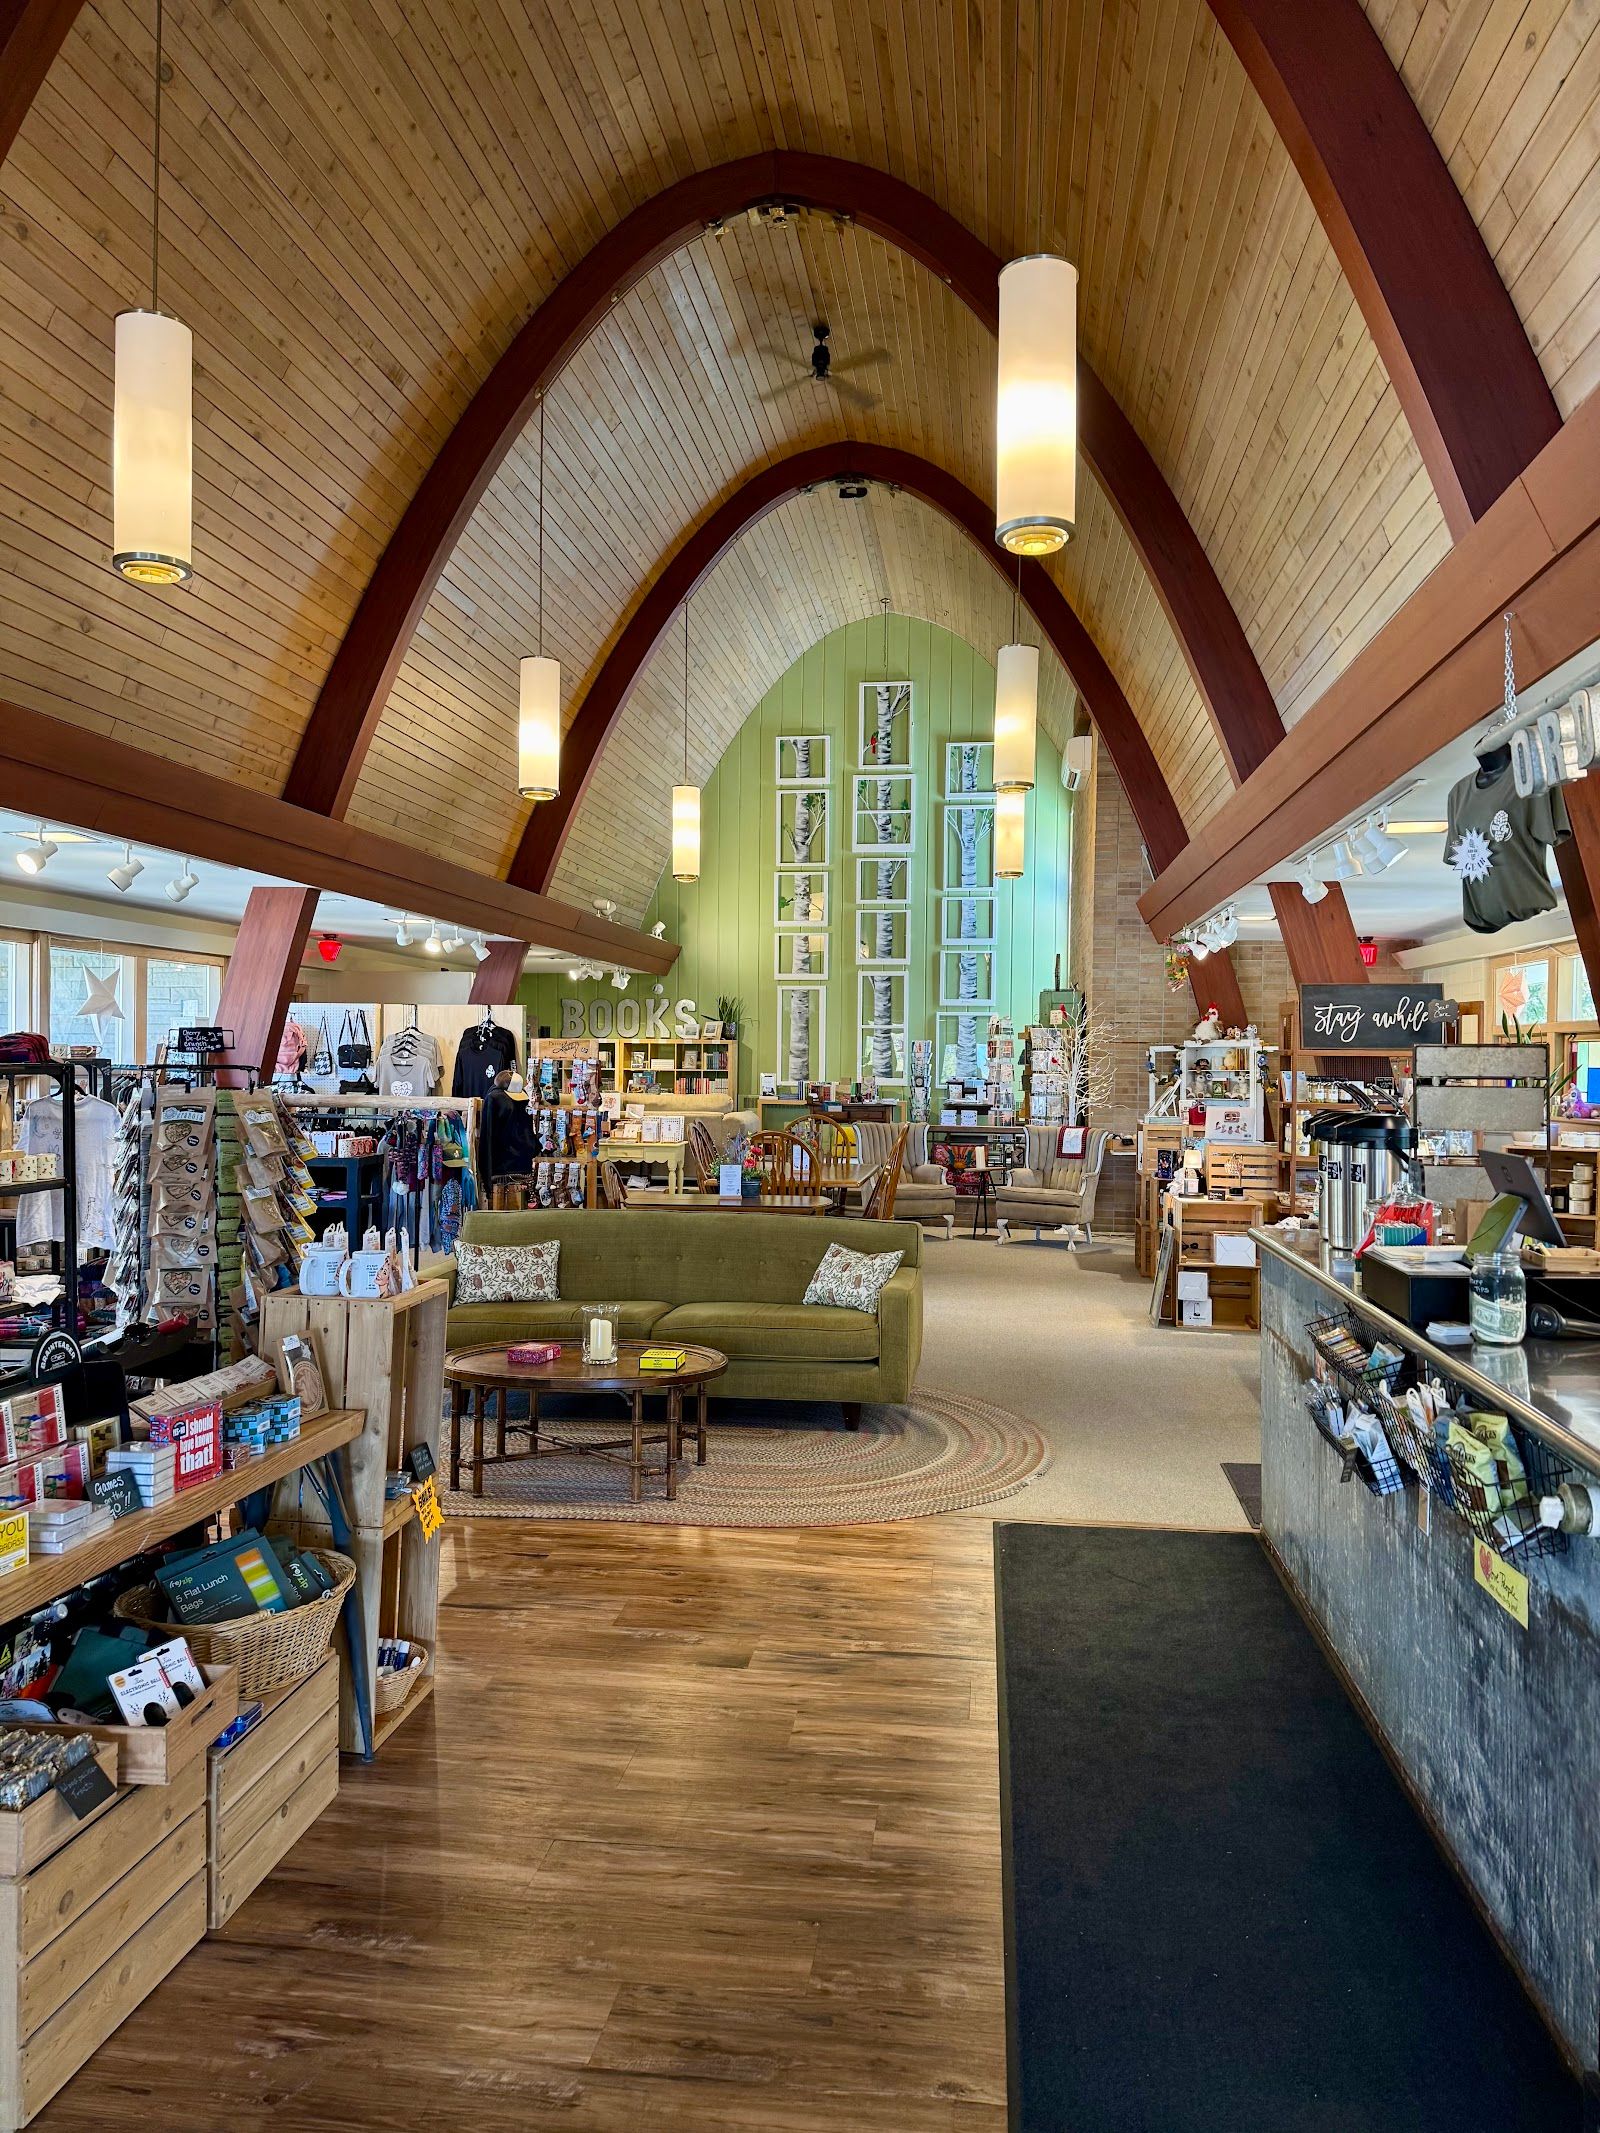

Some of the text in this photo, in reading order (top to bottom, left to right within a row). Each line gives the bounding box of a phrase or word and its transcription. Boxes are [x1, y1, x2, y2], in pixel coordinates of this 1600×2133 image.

[561, 998, 699, 1039] BOOKS
[1314, 996, 1429, 1042] stay awhile
[41, 1340, 76, 1369] BRAINTEASER
[190, 1412, 213, 1435] should
[181, 1443, 213, 1474] that!
[95, 1476, 124, 1496] Games
[112, 1491, 125, 1501] the
[175, 1573, 229, 1603] 5 Flat Lunch
[180, 1597, 204, 1614] Bags
[120, 1681, 150, 1696] ELECTRONIC
